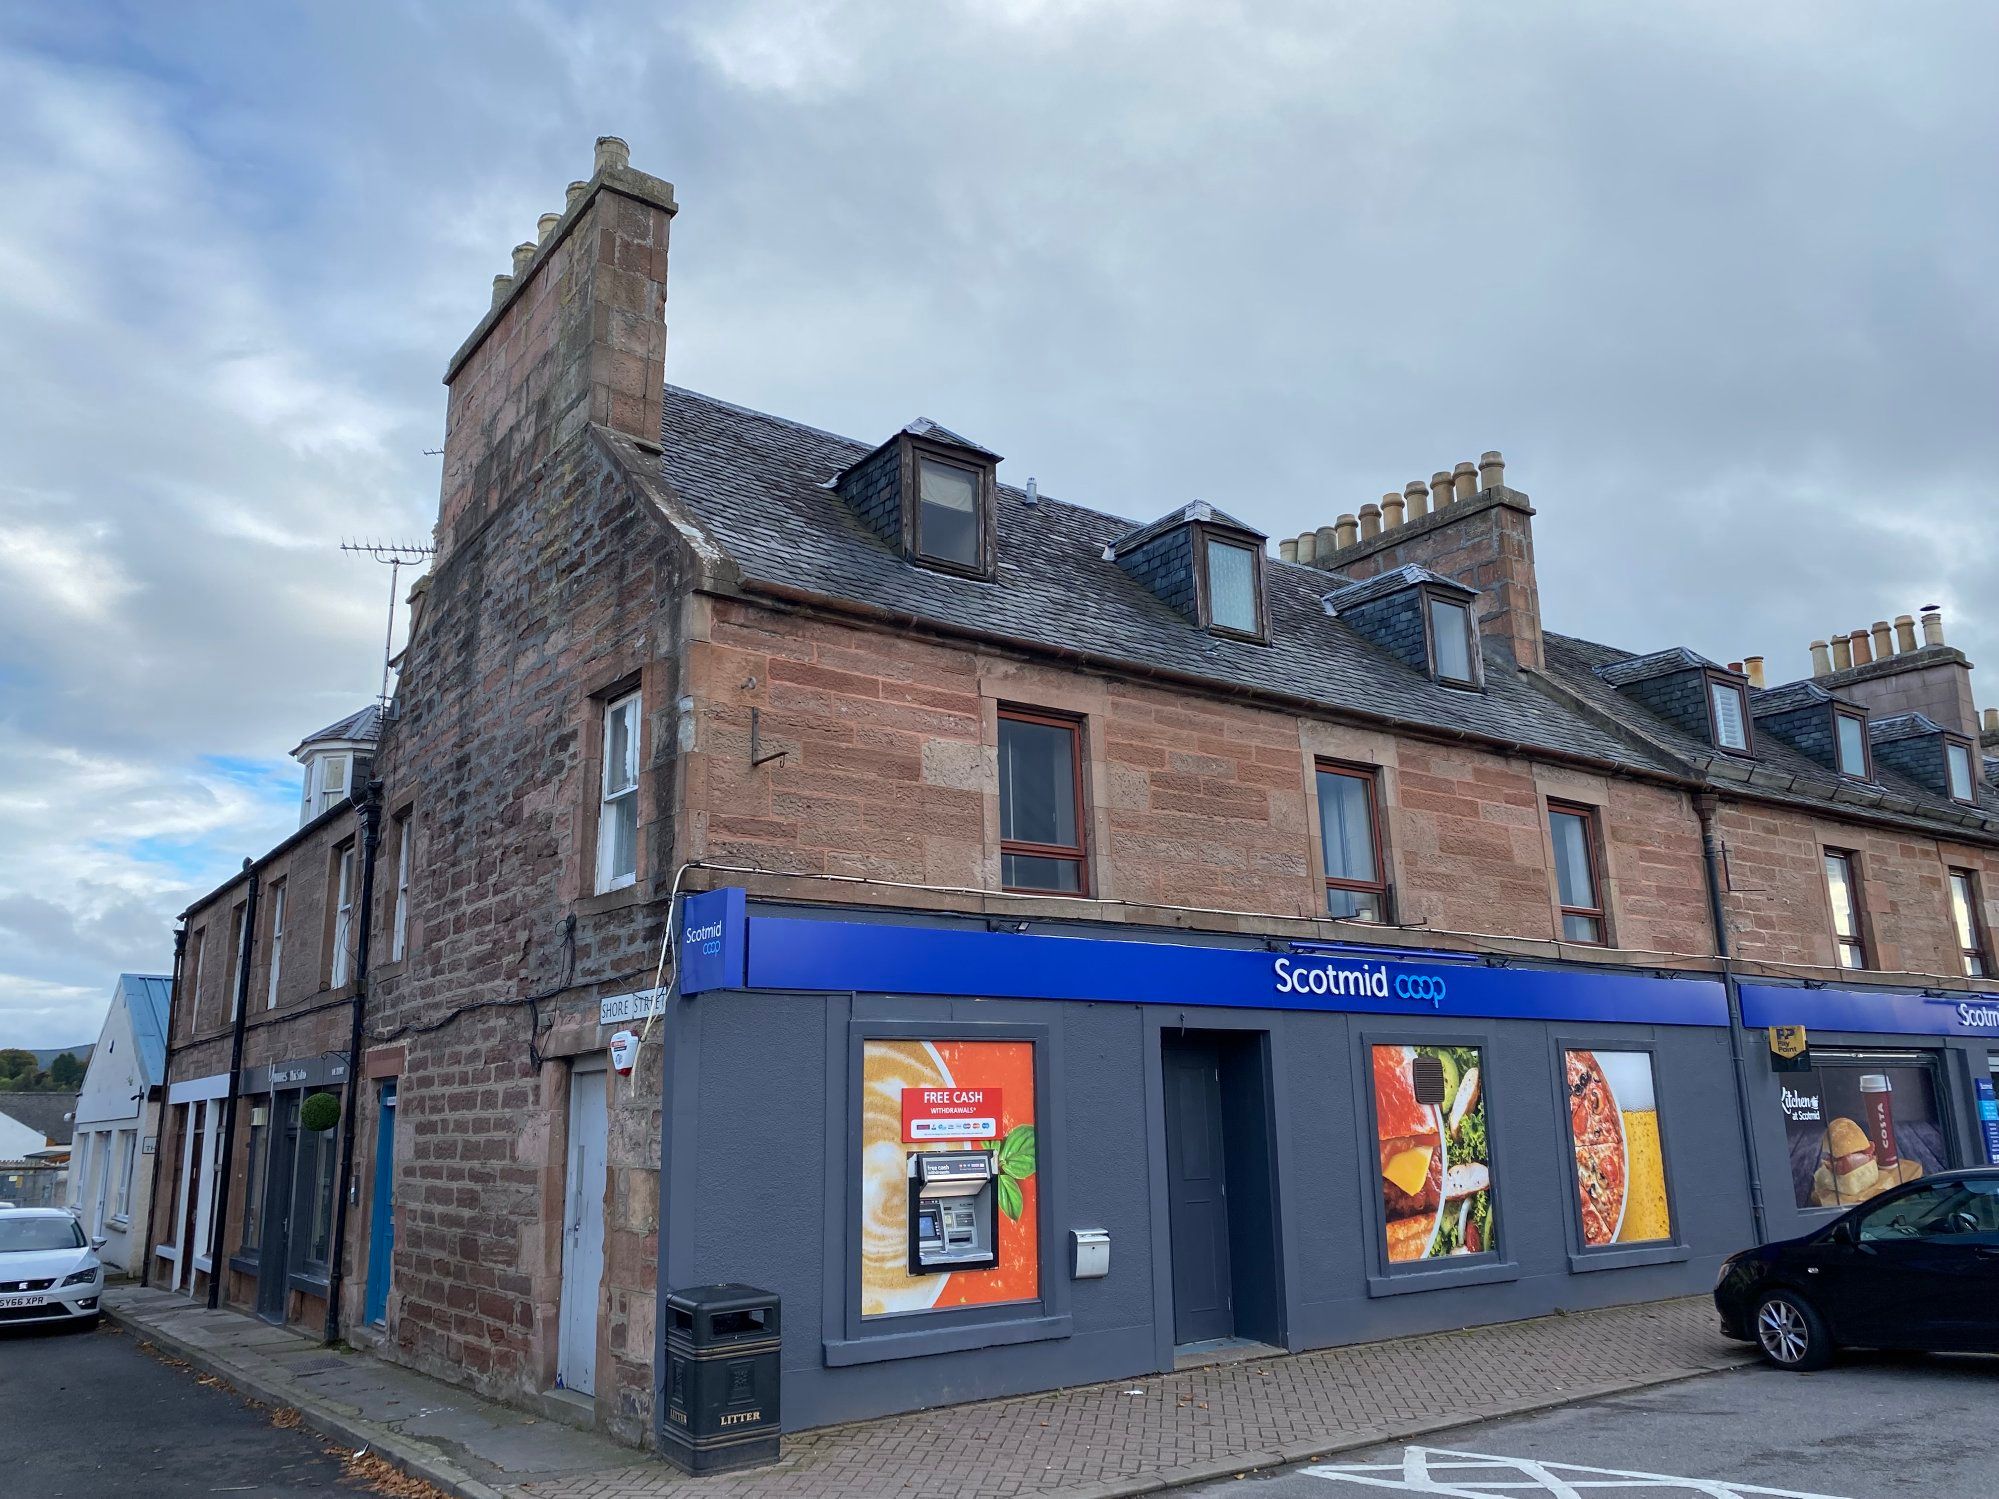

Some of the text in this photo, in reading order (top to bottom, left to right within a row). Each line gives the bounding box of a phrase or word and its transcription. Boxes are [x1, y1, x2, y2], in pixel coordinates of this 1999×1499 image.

[686, 919, 722, 944] Scotmid
[702, 940, 721, 958] coop
[1274, 958, 1447, 1009] Scotmid coop
[602, 1000, 628, 1018] SHORE
[923, 1091, 983, 1104] FREE CASH
[1799, 1110, 1820, 1120] Scotmid
[1878, 1102, 1889, 1149] COSTA
[0, 1296, 44, 1307] SY66 XPR
[720, 1411, 760, 1426] LITTER
